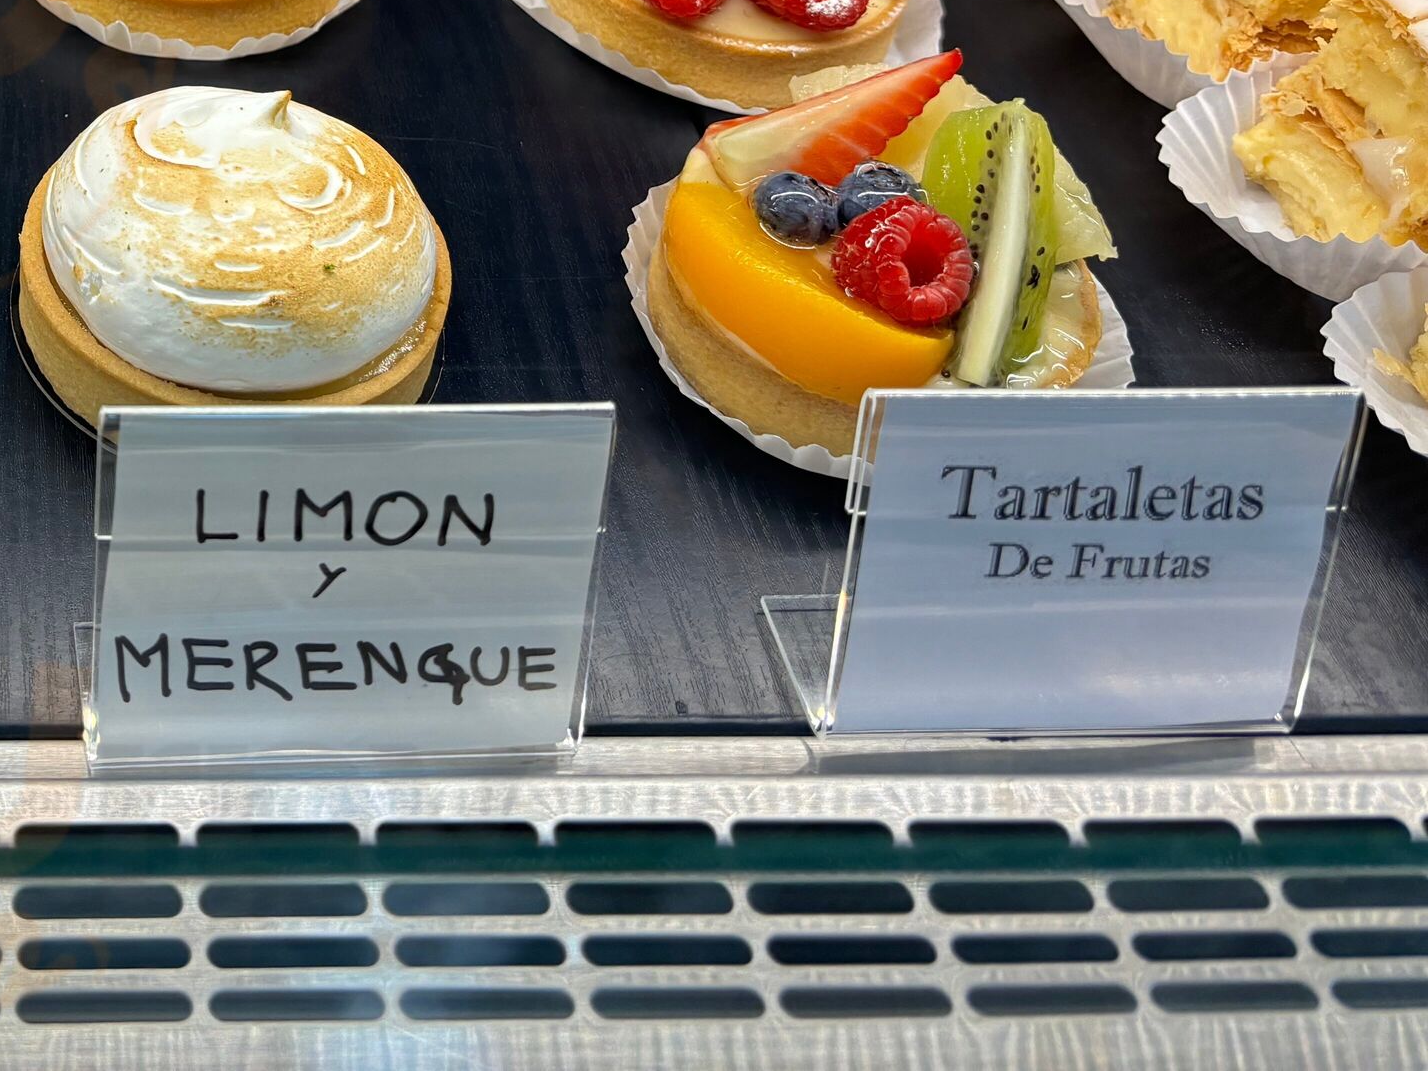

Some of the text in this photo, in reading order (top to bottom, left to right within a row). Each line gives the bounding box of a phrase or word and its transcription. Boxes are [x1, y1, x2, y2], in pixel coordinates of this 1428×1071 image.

[196, 488, 495, 546] LIMON
[941, 464, 1265, 522] Tartaletas
[983, 542, 1212, 579] De Frutas
[114, 632, 558, 705] MERENGUE
